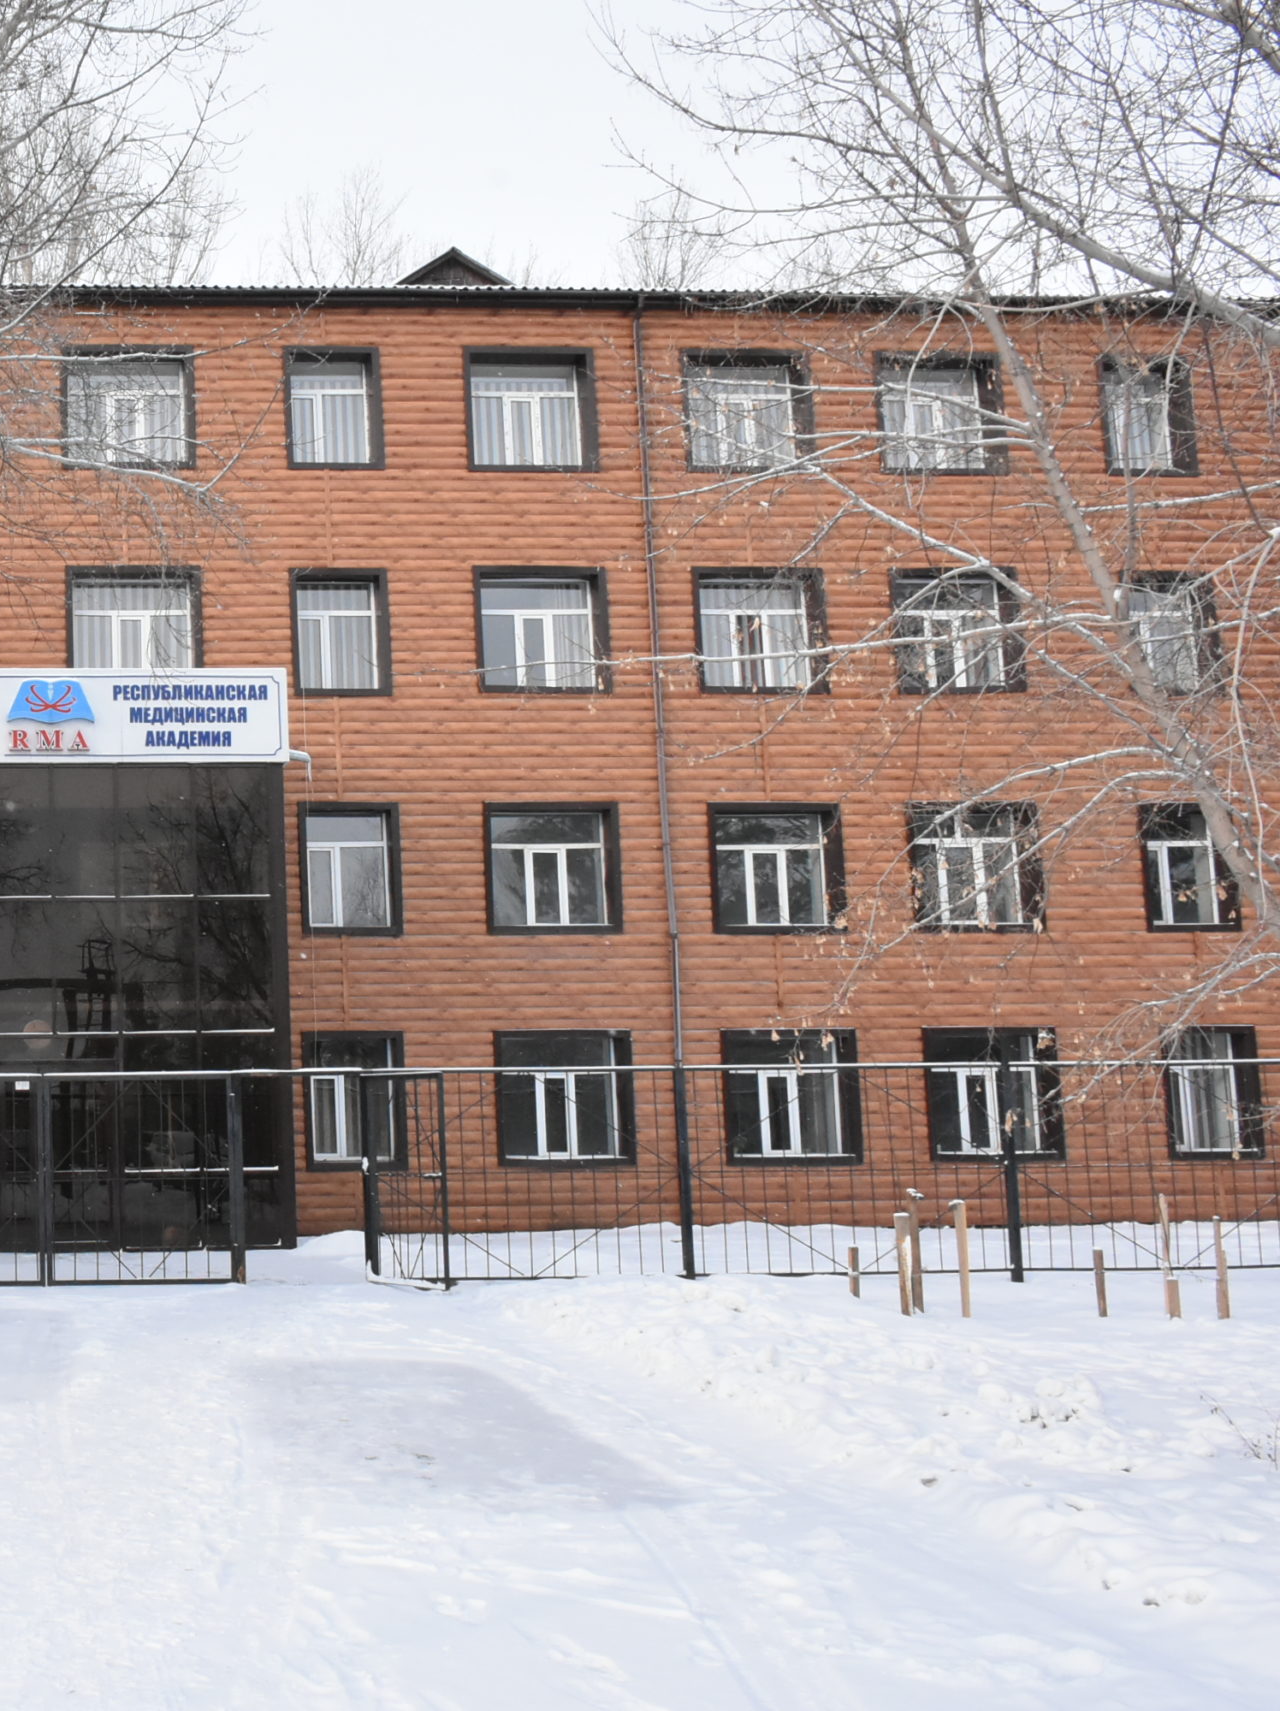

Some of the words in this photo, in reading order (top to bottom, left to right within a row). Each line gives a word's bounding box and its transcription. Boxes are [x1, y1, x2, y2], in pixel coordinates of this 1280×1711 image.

[112, 684, 268, 701] РЕСПУБЛИКАНСКАЯ
[129, 706, 248, 725] МЕДИЦИНСКАЯ
[9, 729, 90, 753] RMA
[144, 730, 232, 750] АКАДЕМИЯ
